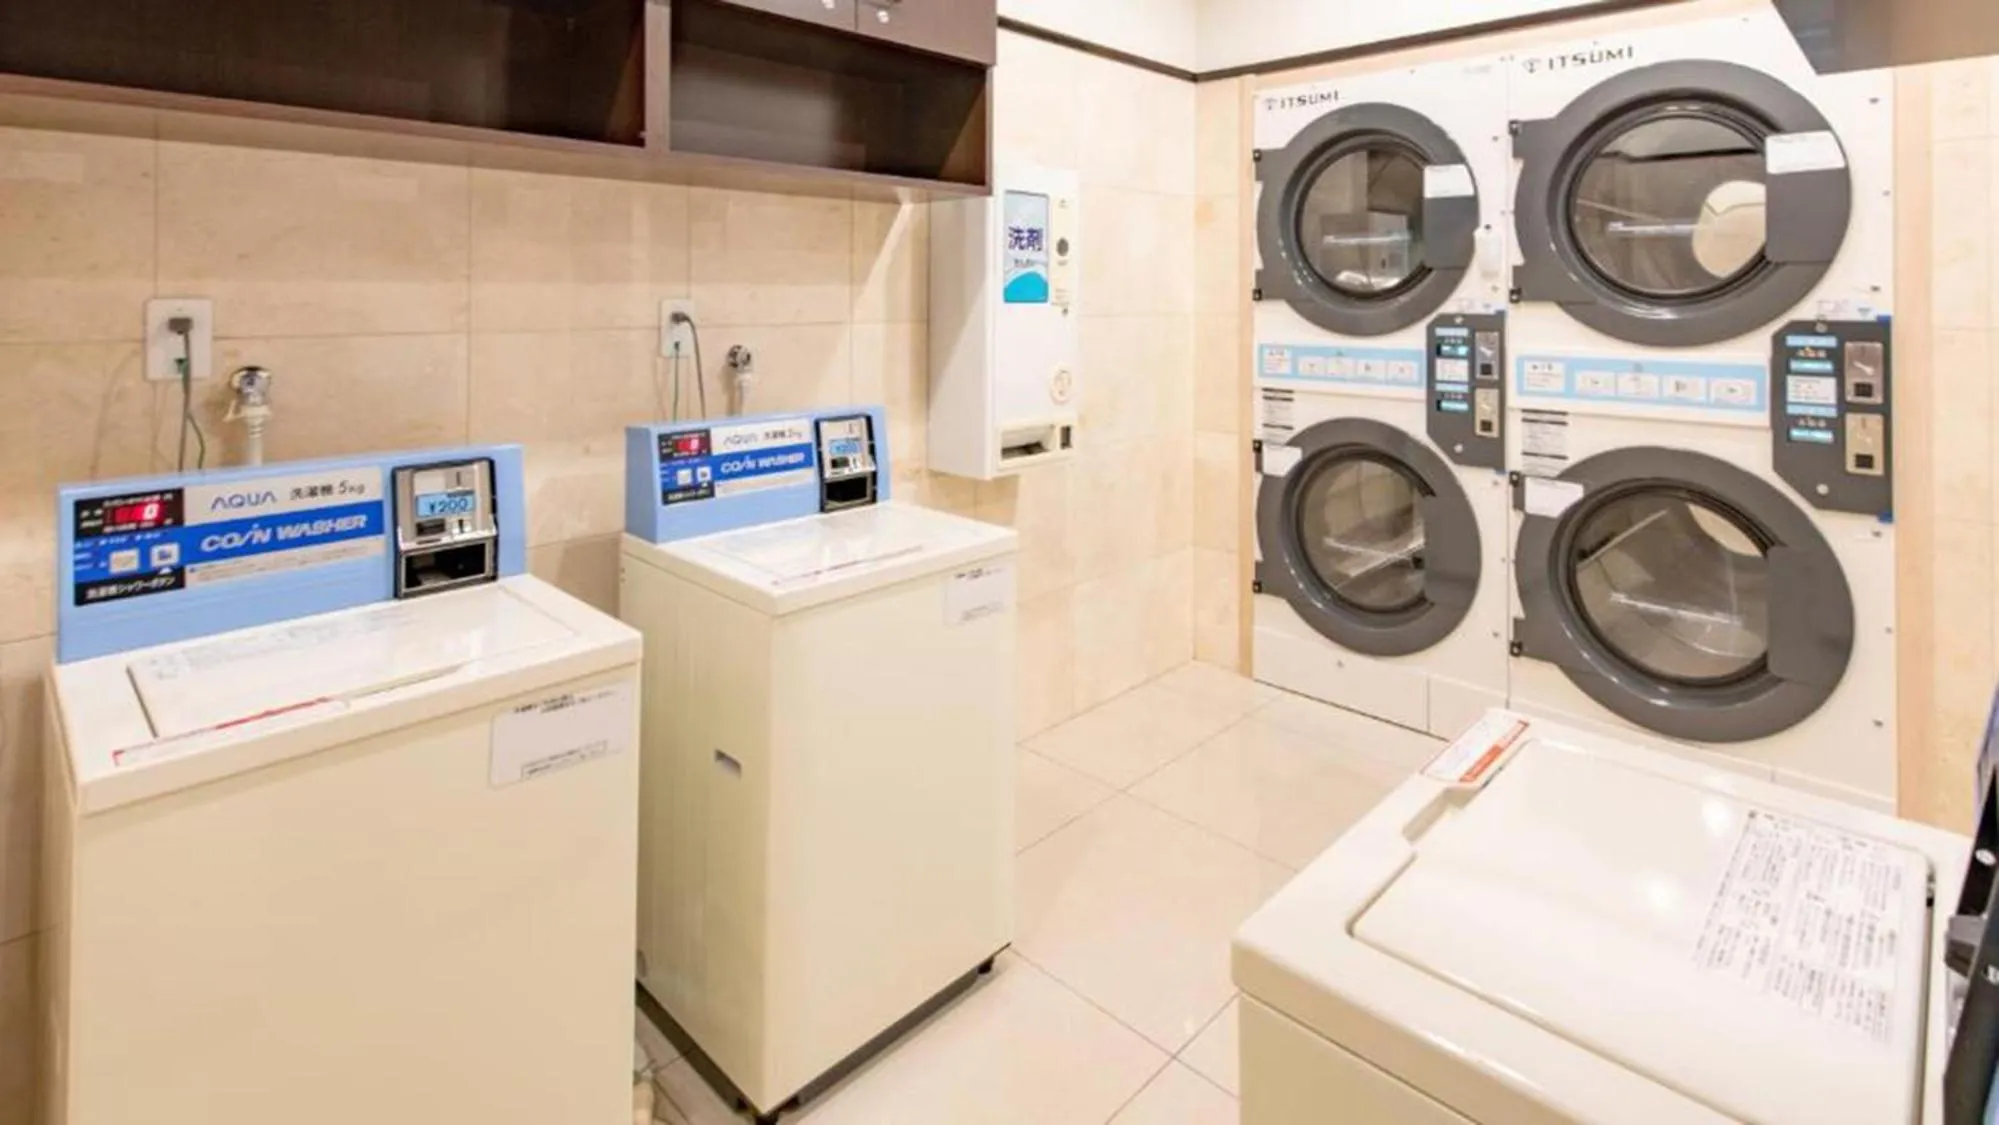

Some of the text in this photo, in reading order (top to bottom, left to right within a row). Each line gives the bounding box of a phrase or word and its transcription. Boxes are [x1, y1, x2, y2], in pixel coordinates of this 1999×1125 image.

[1548, 46, 1633, 71] ITSUMI
[1280, 89, 1339, 109] ITSUMI
[1007, 225, 1044, 252] 洗剤
[210, 490, 278, 511] AQUA
[428, 497, 469, 514] ¥200
[200, 522, 273, 552] COIN
[275, 514, 369, 542] WASHER
